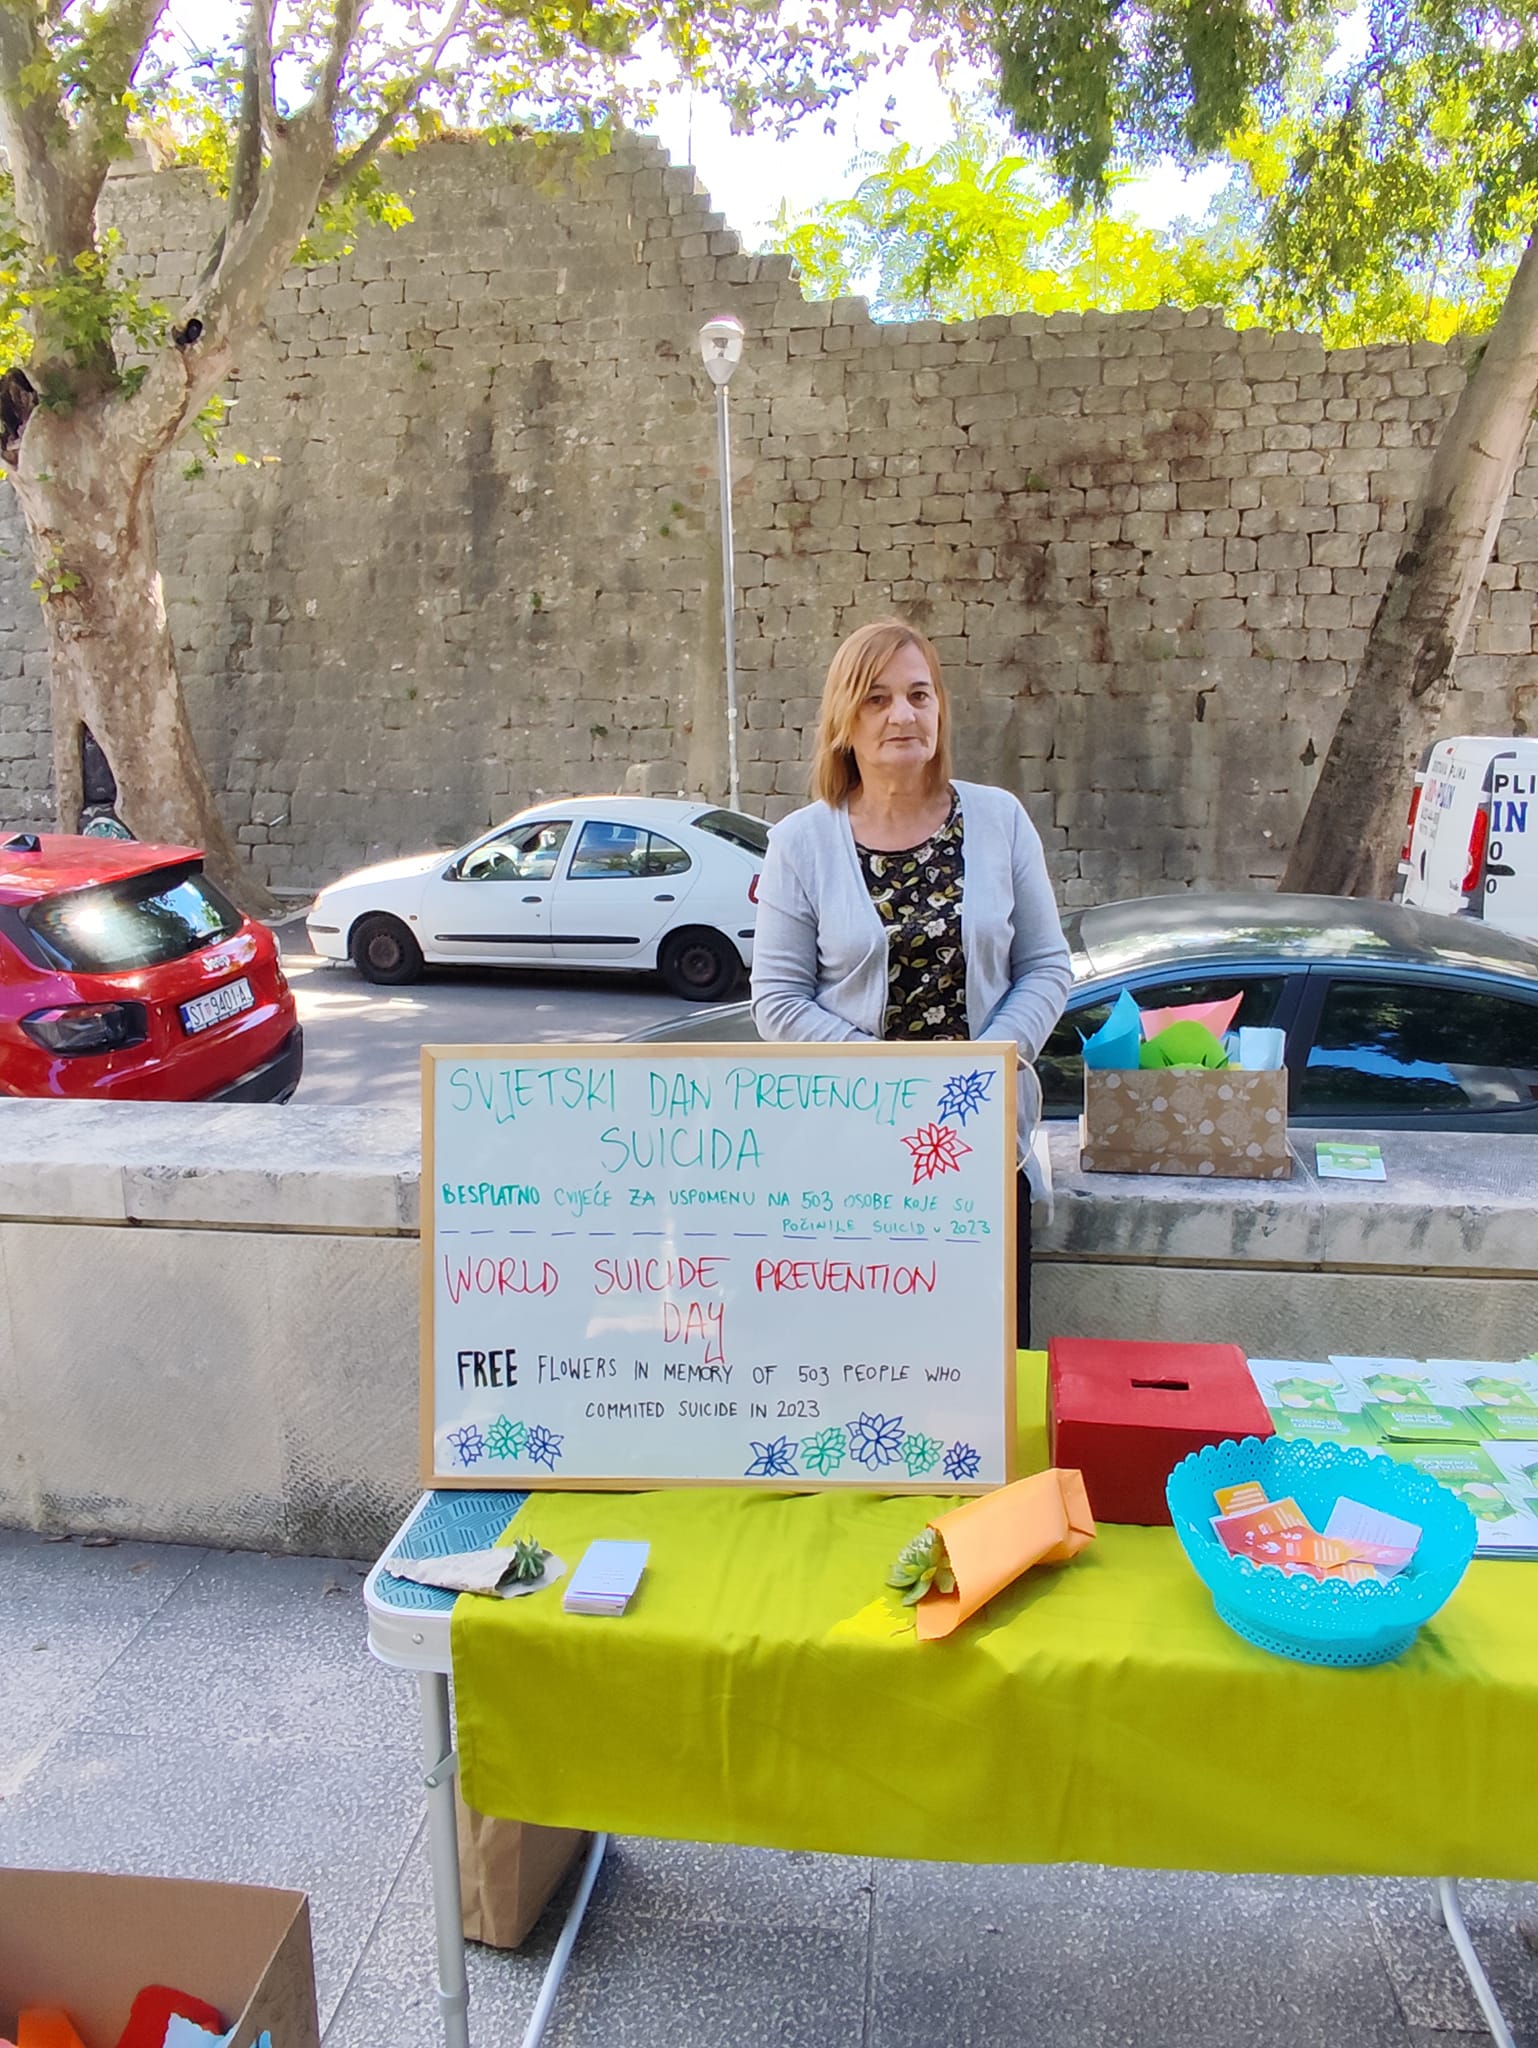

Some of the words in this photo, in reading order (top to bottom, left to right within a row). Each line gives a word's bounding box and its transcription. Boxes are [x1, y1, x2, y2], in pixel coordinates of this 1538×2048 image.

[1494, 774, 1536, 794] PLI
[1492, 801, 1528, 832] IN
[189, 1002, 206, 1025] ST
[450, 1067, 616, 1124] SVJETSKI
[650, 1072, 711, 1119] DAN
[726, 1067, 931, 1126] PREVENCIJE
[600, 1127, 766, 1173] SUICIDA
[442, 1182, 541, 1206] BESPLATNO
[629, 1189, 655, 1206] ZA
[669, 1189, 756, 1206] USPOMENU
[768, 1193, 790, 1207] NA
[802, 1191, 834, 1212] 503
[844, 1193, 893, 1210] OSOBE
[903, 1196, 938, 1212] KOJE
[953, 1199, 974, 1212] SU
[873, 1219, 926, 1234] SUICID
[950, 1220, 991, 1234] 2023
[444, 1254, 559, 1304] WORLD
[594, 1257, 731, 1295] SUICIDE
[755, 1258, 937, 1295] PREVENTION
[663, 1301, 725, 1364] DAY
[457, 1349, 518, 1390] FREE
[538, 1355, 617, 1384] FLOWERS
[634, 1360, 649, 1381] IN
[664, 1363, 733, 1384] MEMORY
[752, 1365, 778, 1385] OF
[798, 1365, 830, 1387] 503
[843, 1364, 911, 1383] PEOPLE
[925, 1366, 961, 1383] WHO
[585, 1402, 665, 1418] COMMITED
[678, 1400, 738, 1417] SUICIDE
[750, 1403, 767, 1418] IN
[776, 1400, 821, 1418] 2023
